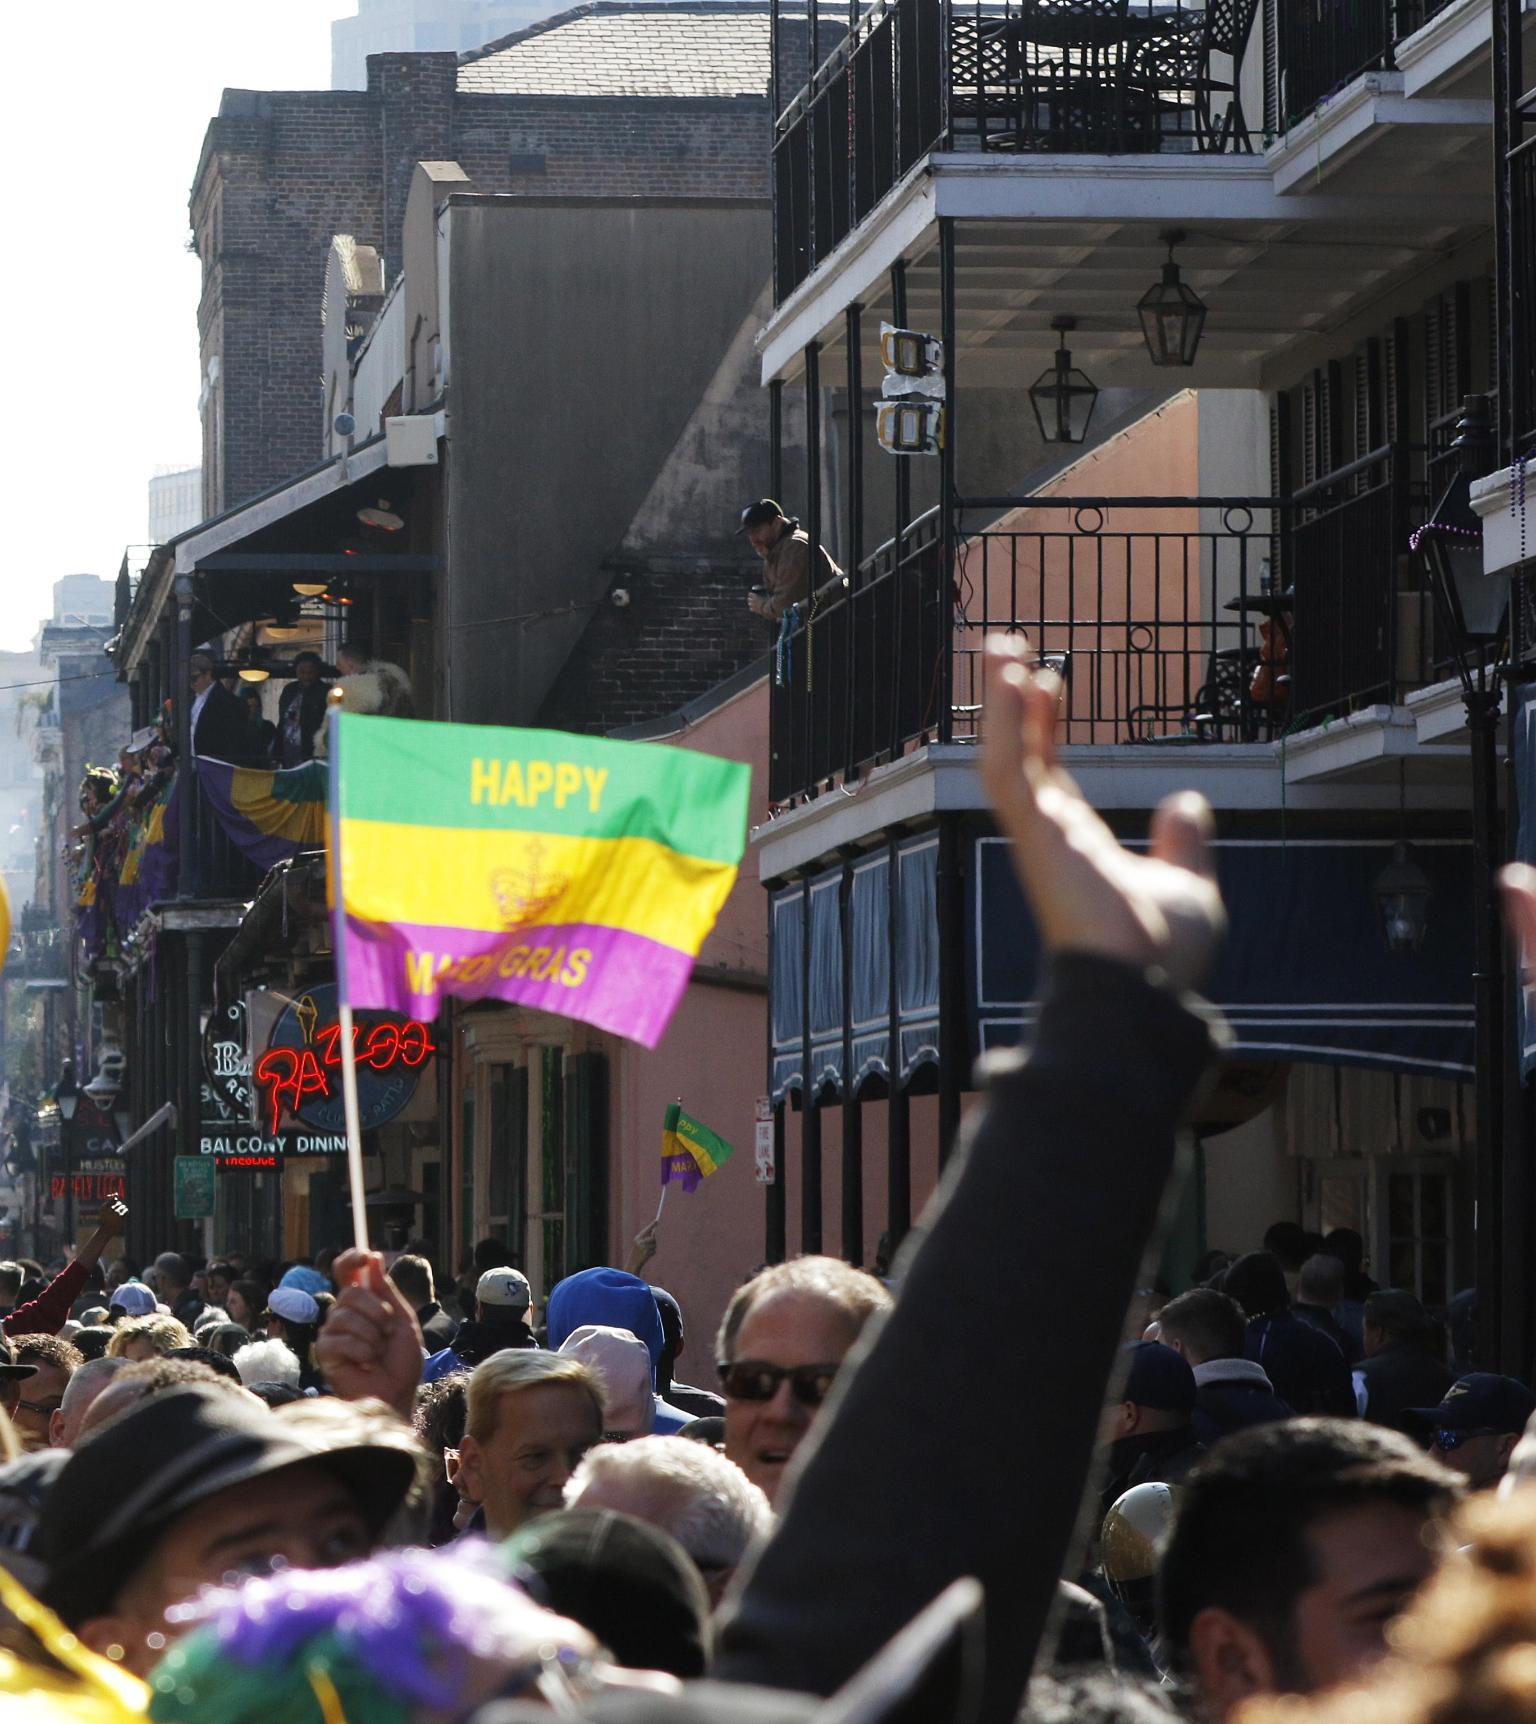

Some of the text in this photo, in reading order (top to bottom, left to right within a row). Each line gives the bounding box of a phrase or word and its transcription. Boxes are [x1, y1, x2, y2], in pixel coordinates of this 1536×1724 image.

[470, 758, 609, 813] HAPPY
[497, 945, 593, 987] GRAS
[201, 1136, 352, 1155] BALCONY DININ
